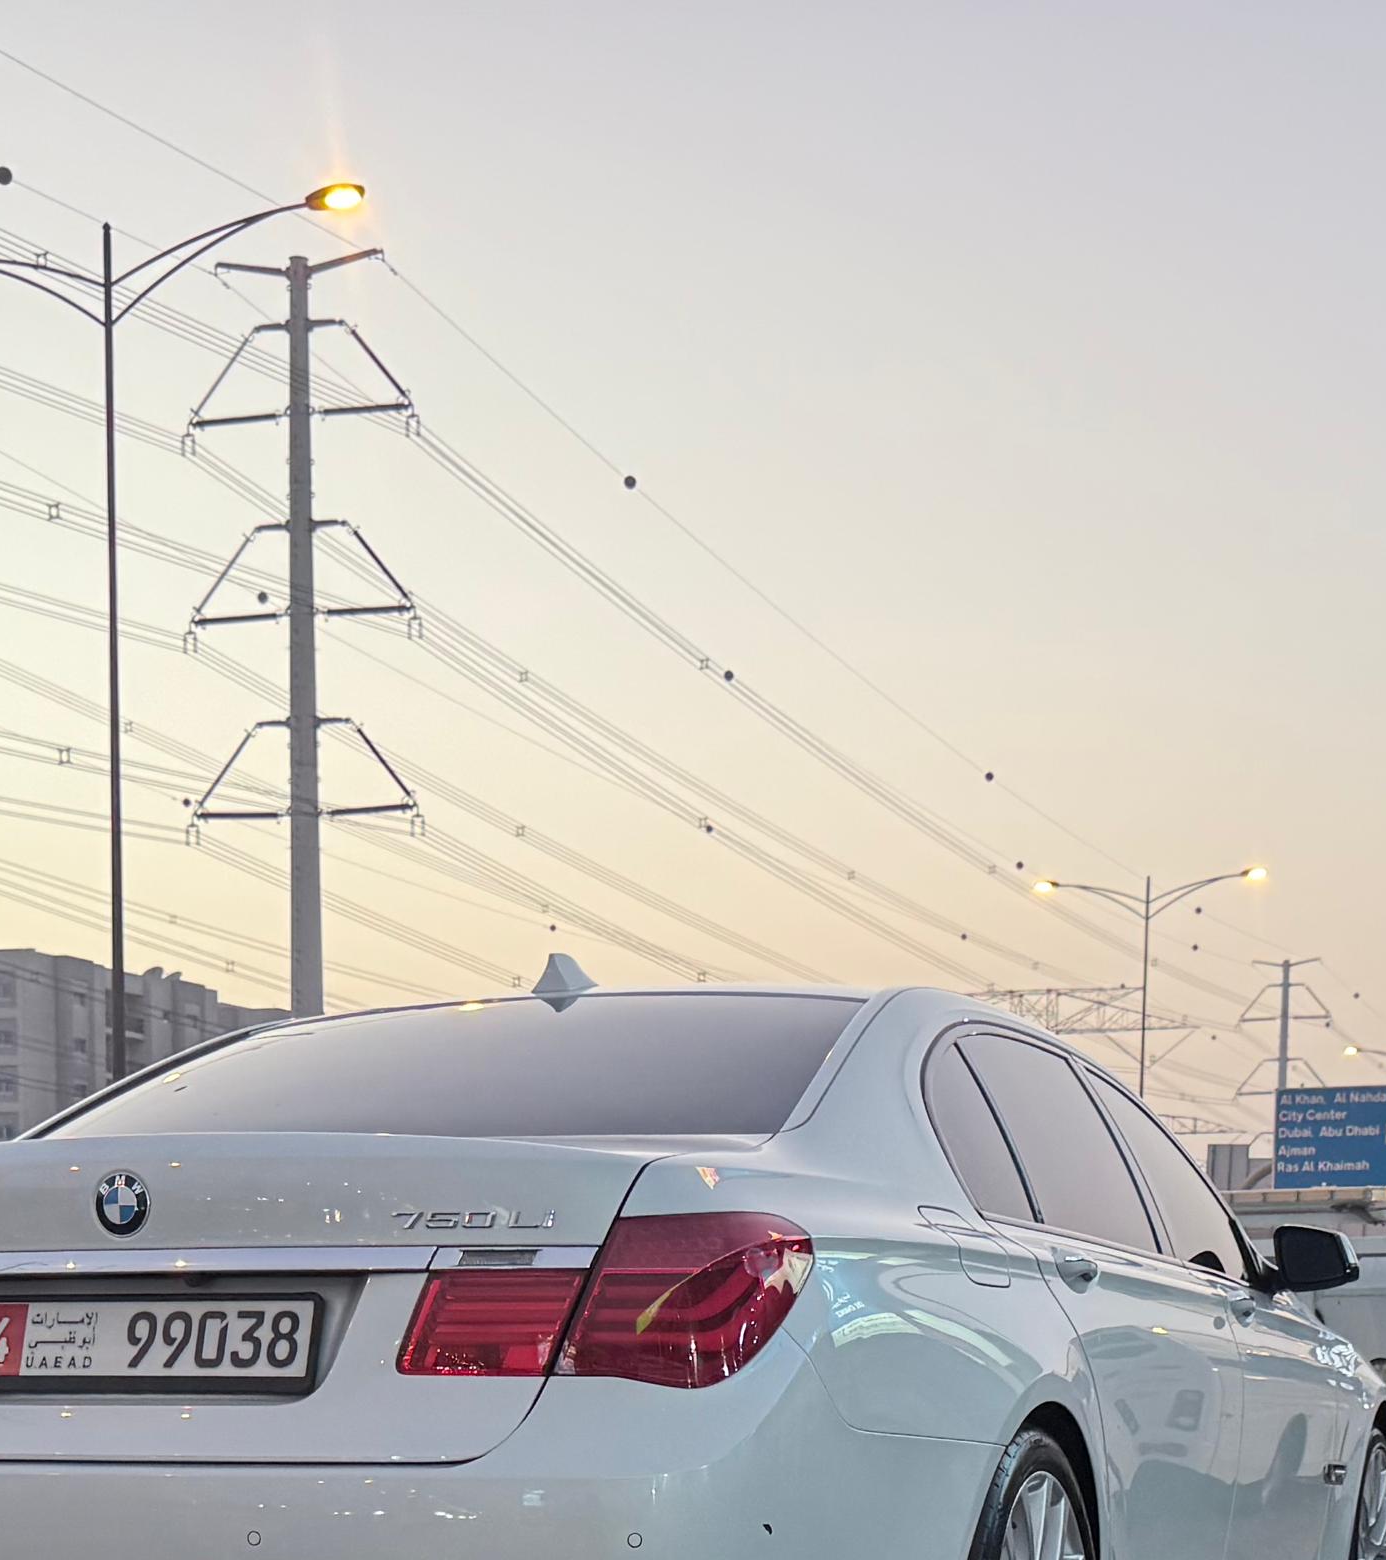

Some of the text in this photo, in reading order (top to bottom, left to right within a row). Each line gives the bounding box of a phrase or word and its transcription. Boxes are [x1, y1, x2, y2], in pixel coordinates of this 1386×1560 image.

[1280, 1095, 1292, 1105] Al
[1334, 1093, 1346, 1103] Al
[1279, 1109, 1348, 1122] City Center
[1319, 1126, 1343, 1137] Abu
[1345, 1125, 1380, 1136] Dhabi
[1278, 1145, 1316, 1158] Ajman
[1277, 1160, 1370, 1173] Ras Al Khaimah
[99, 1175, 145, 1195] BMW
[126, 1311, 300, 1369] 99038
